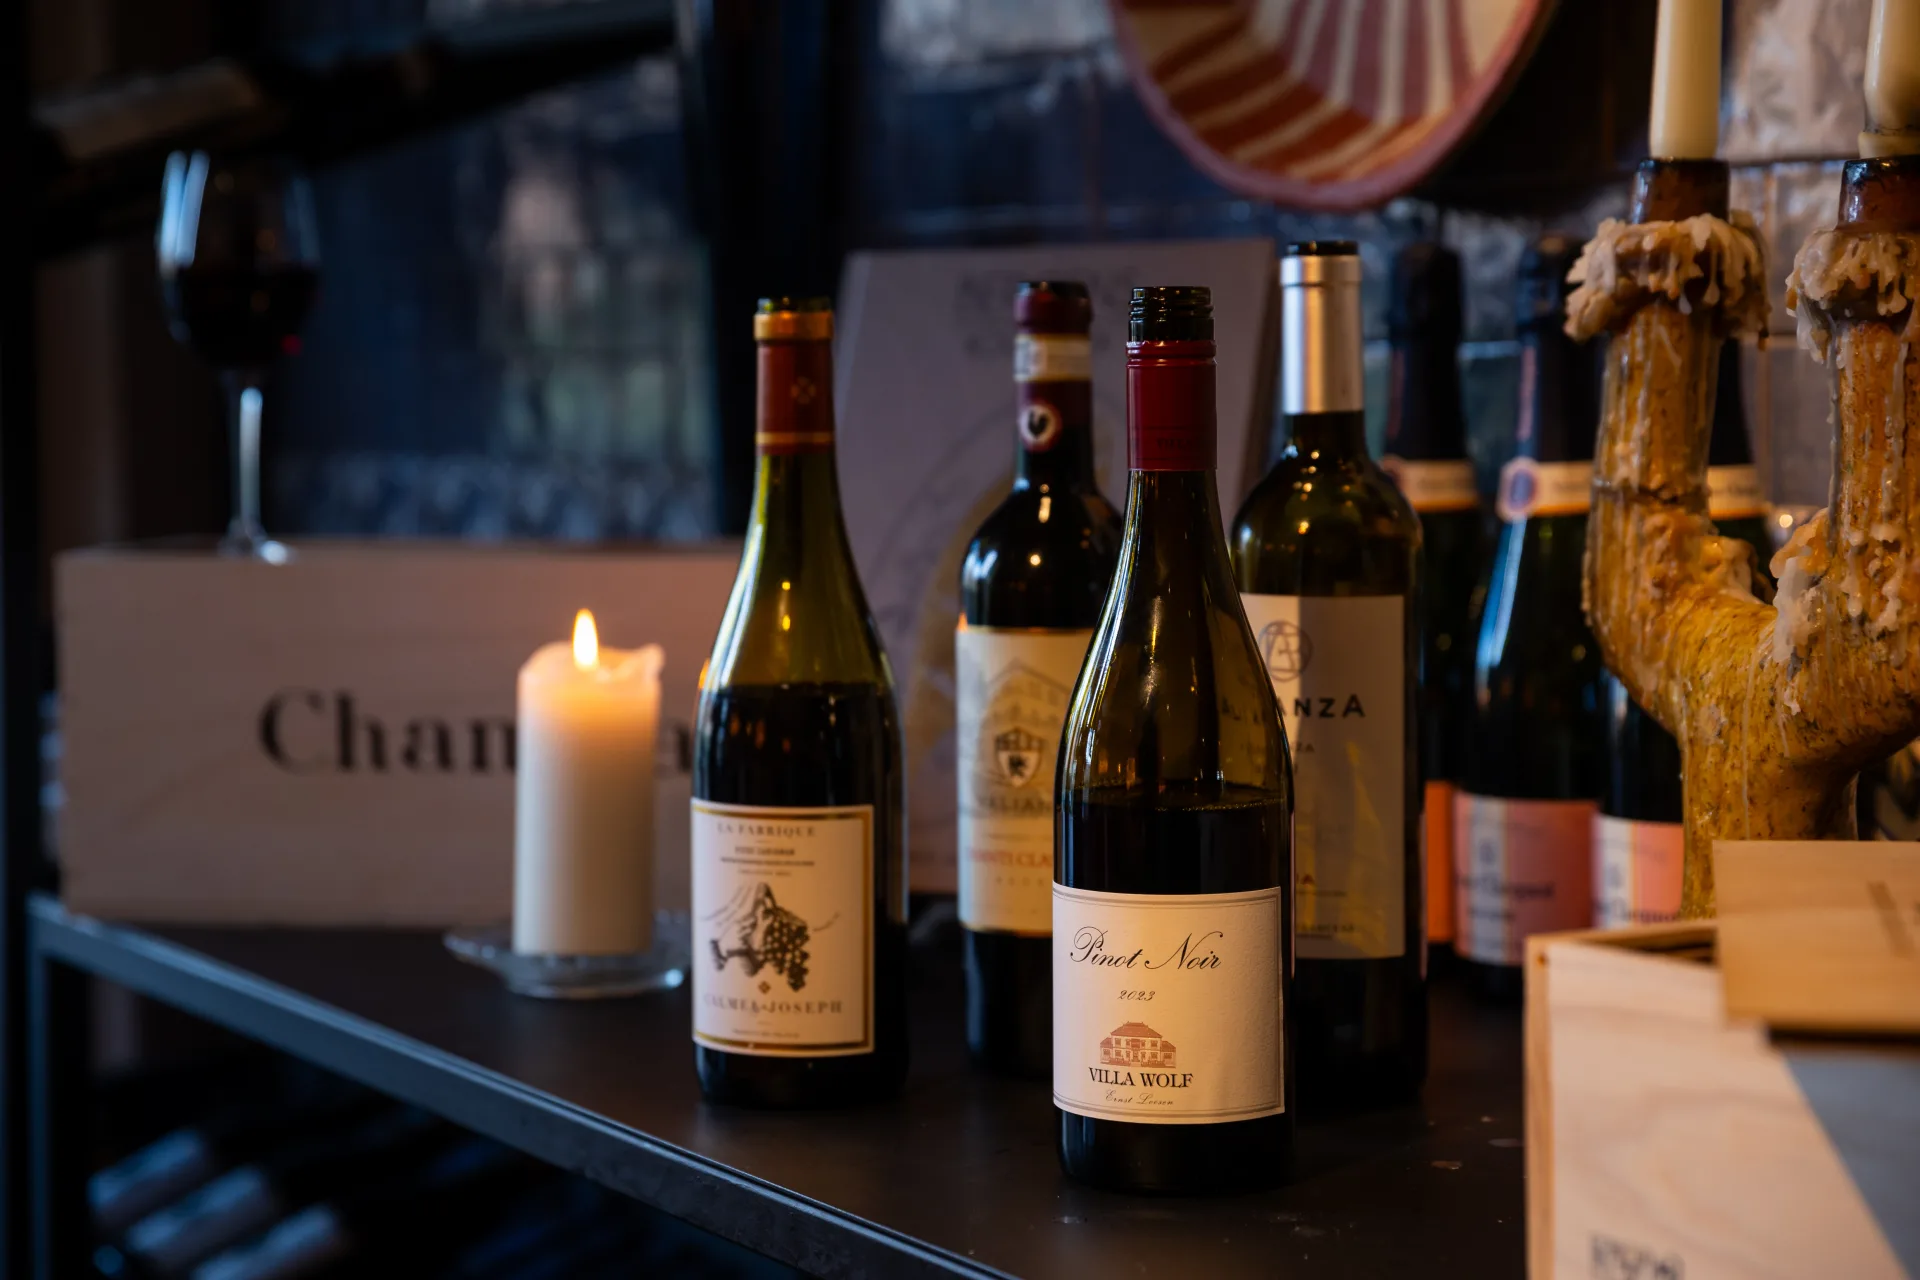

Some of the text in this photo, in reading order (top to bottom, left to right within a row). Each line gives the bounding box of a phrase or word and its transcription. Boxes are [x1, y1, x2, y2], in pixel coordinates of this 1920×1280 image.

[738, 825, 817, 838] FABRIQUE
[1070, 925, 1224, 970] Pinot Noir
[1117, 989, 1156, 1002] 2023
[767, 999, 844, 1015] JOSEPH
[1088, 1067, 1194, 1089] VILLA WOLF
